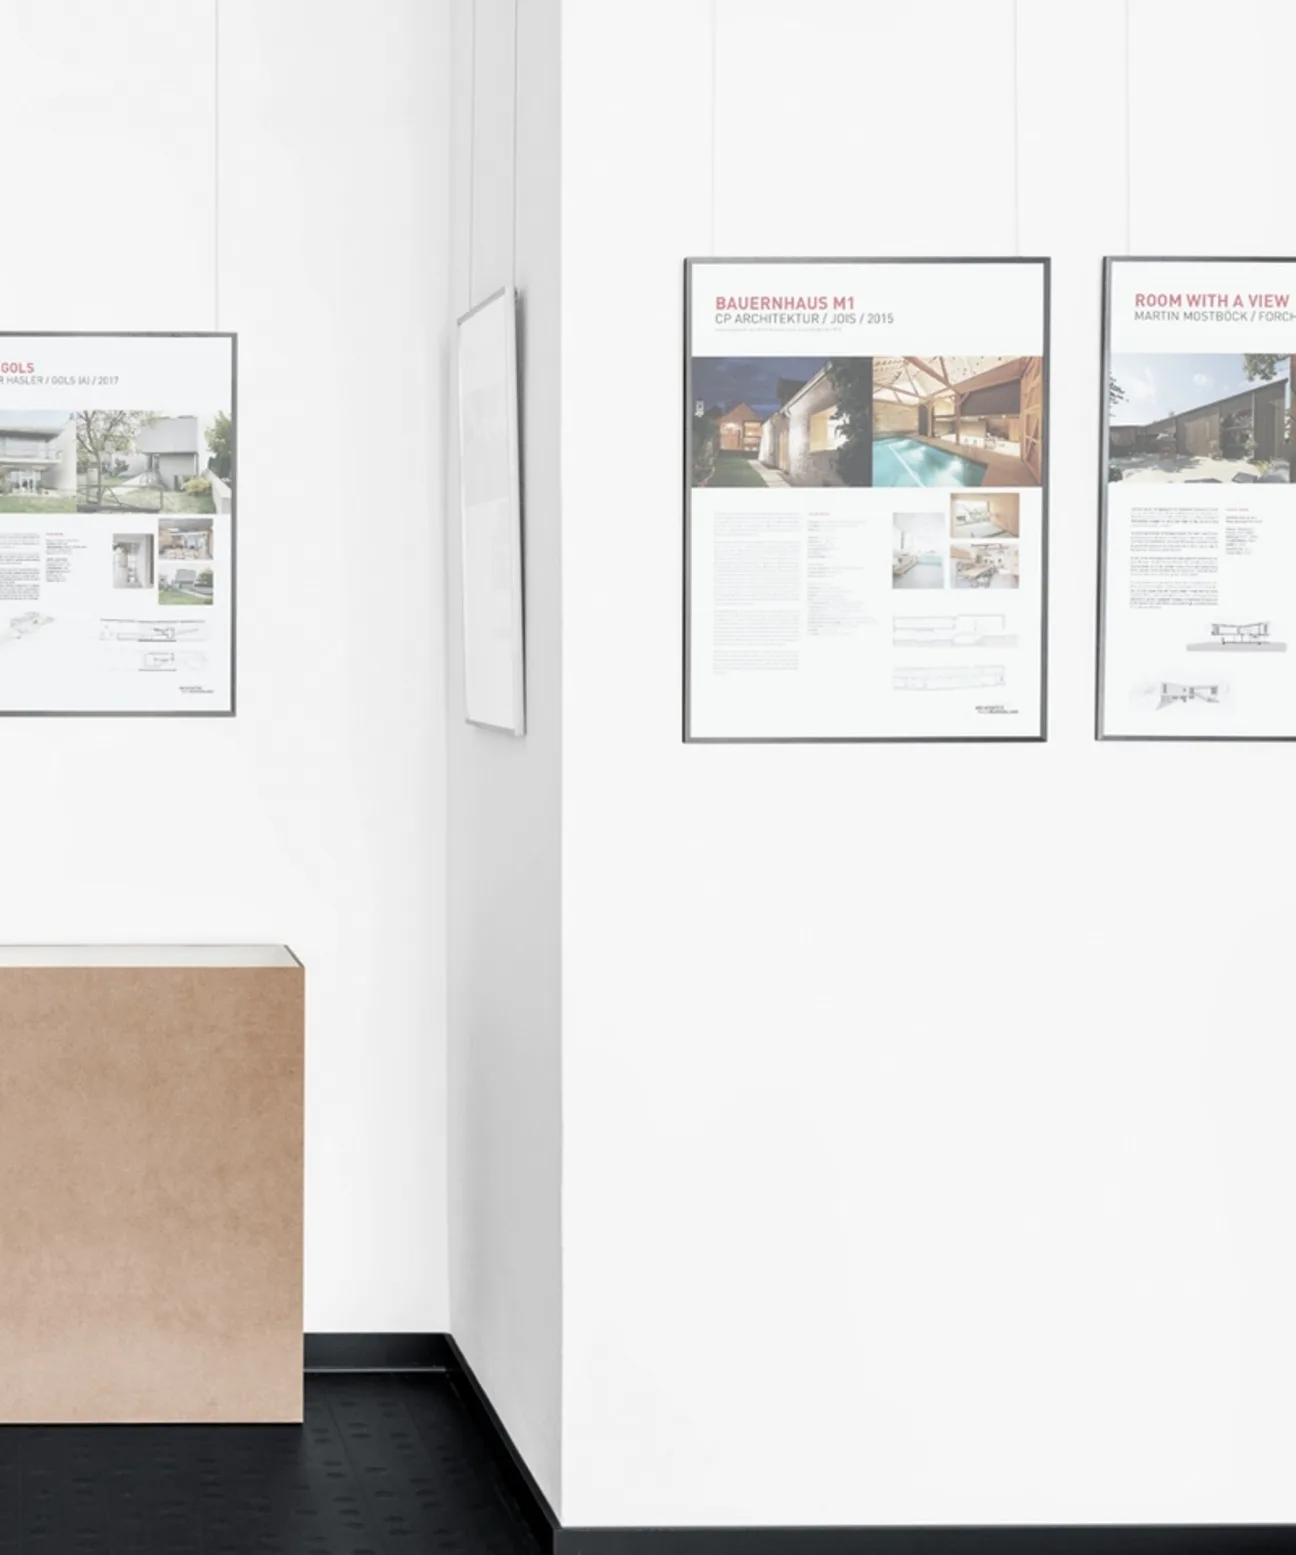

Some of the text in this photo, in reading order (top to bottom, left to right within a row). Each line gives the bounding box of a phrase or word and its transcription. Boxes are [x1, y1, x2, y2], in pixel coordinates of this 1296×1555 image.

[715, 296, 855, 310] BAUERNHAUS M1
[1135, 293, 1290, 308] ROOM WITH A VIEW
[715, 313, 732, 324] CP
[734, 313, 819, 324] ARCHITEKTUR
[830, 313, 857, 324] JOIS
[867, 313, 894, 324] 2015
[1134, 311, 1180, 321] MARTIN
[1184, 309, 1248, 322] MOSTBÖCK
[1, 362, 35, 374] GOLS
[51, 376, 76, 385] GOLS
[97, 376, 119, 386] 2017
